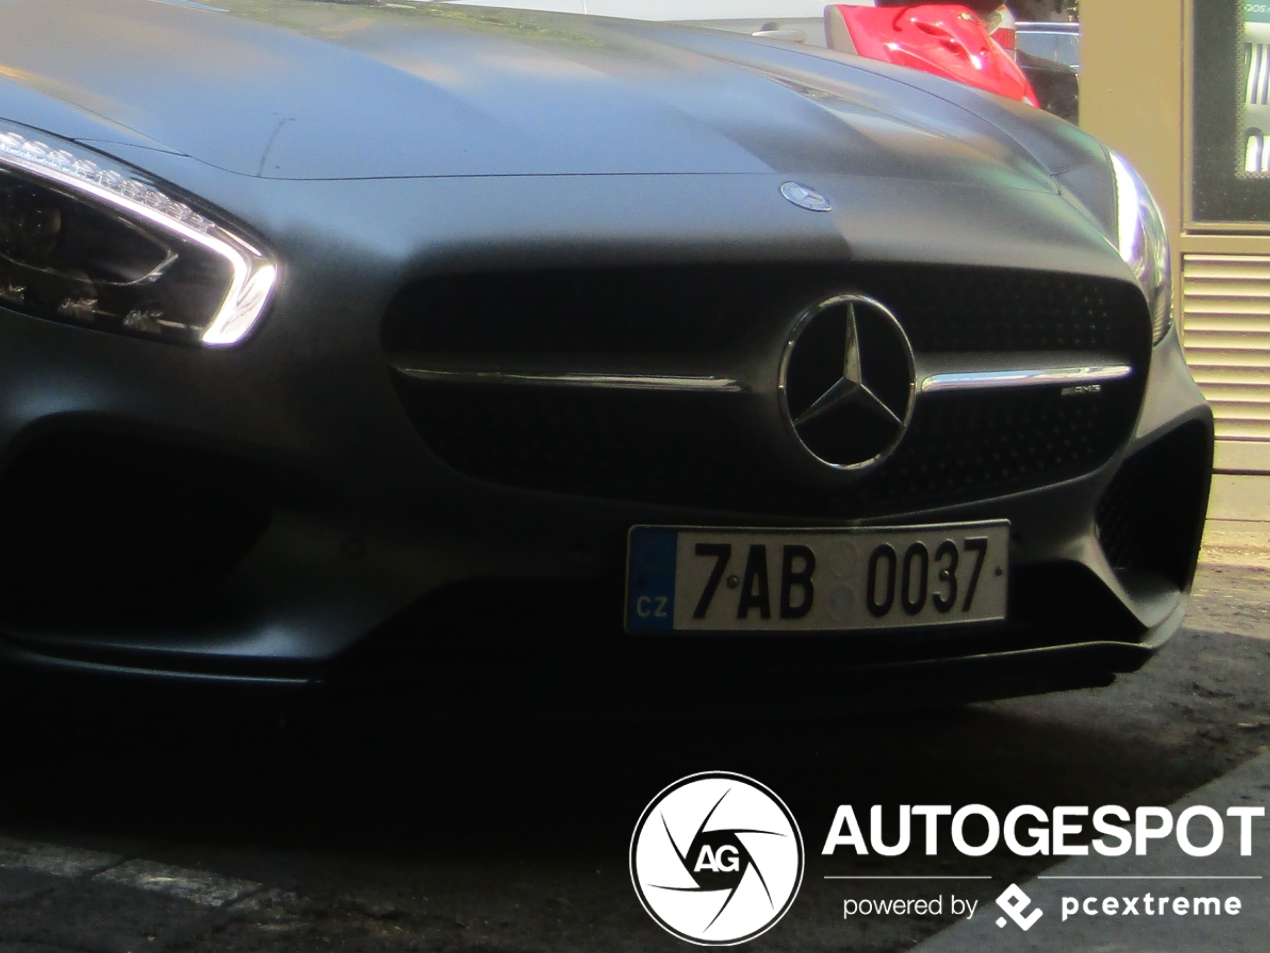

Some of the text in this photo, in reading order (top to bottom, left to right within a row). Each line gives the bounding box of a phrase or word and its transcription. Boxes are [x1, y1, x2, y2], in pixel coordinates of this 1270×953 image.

[692, 535, 989, 619] 7AB 0037
[636, 596, 668, 618] CZ
